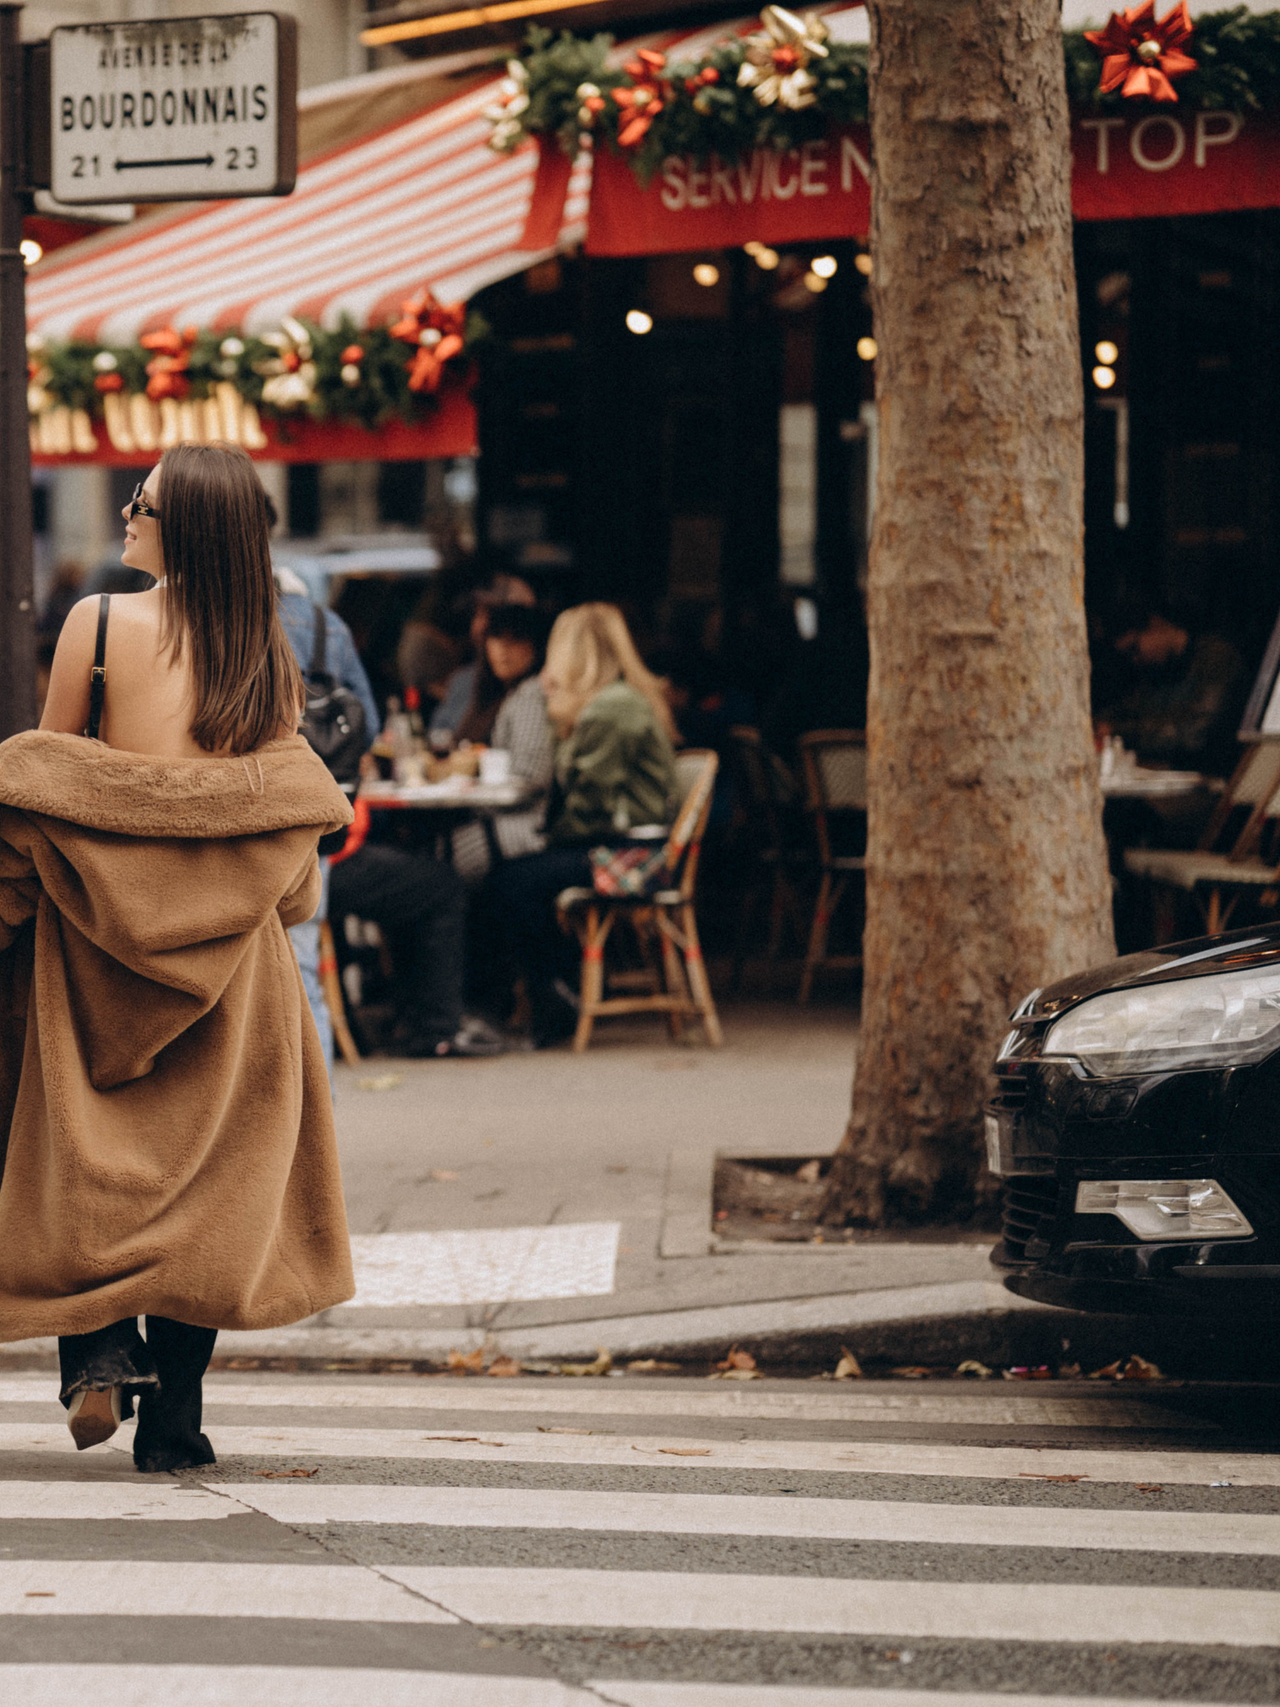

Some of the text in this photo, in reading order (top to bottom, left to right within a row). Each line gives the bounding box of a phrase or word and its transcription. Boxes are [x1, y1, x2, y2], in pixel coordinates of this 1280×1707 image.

[60, 84, 268, 132] BOURDONNAIS
[71, 146, 259, 178] 21 23
[660, 138, 828, 212] SERVICE
[1079, 110, 1245, 175] TOP
